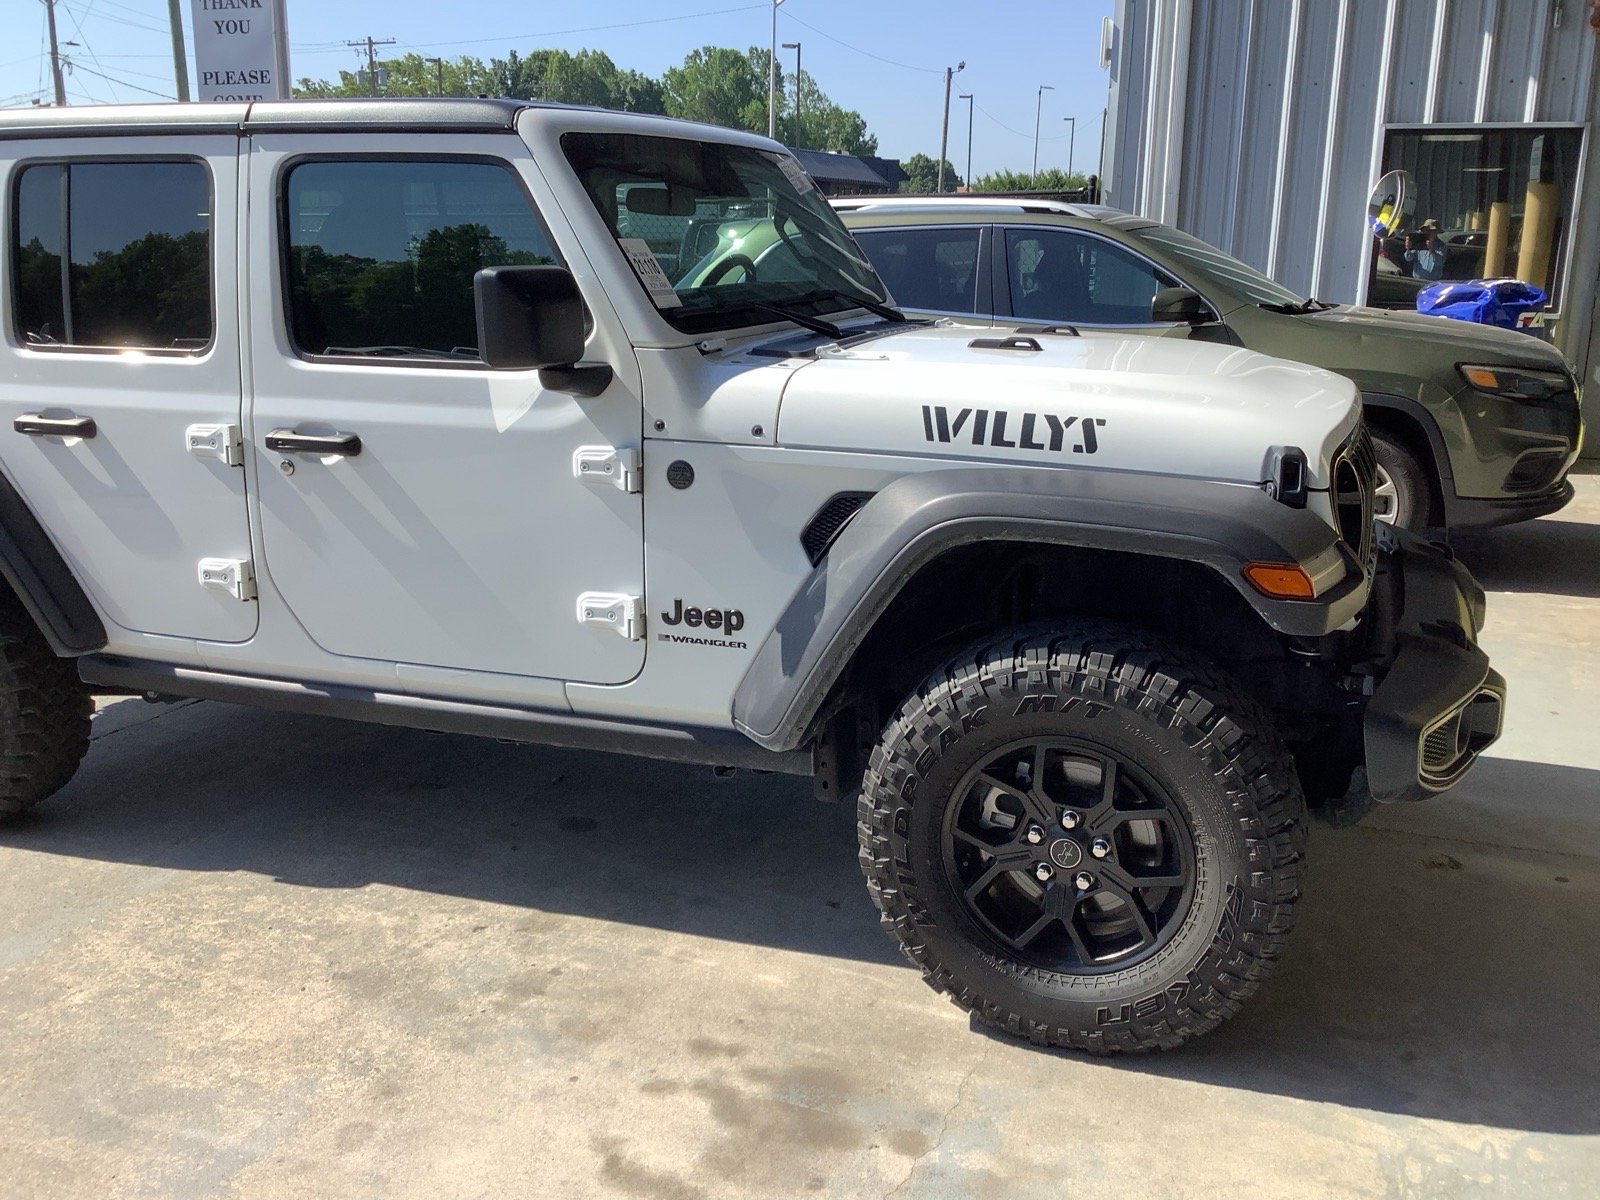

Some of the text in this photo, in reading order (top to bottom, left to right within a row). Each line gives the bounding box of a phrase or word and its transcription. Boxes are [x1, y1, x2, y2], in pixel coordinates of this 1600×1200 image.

[202, 0, 263, 10] THANK
[213, 20, 251, 34] YOU
[202, 70, 271, 85] PLEASE
[922, 405, 1106, 454] WILLYS
[661, 597, 745, 636] Jeep
[671, 635, 748, 649] WRANGLER
[893, 694, 1113, 928] WILDPEAK M/T
